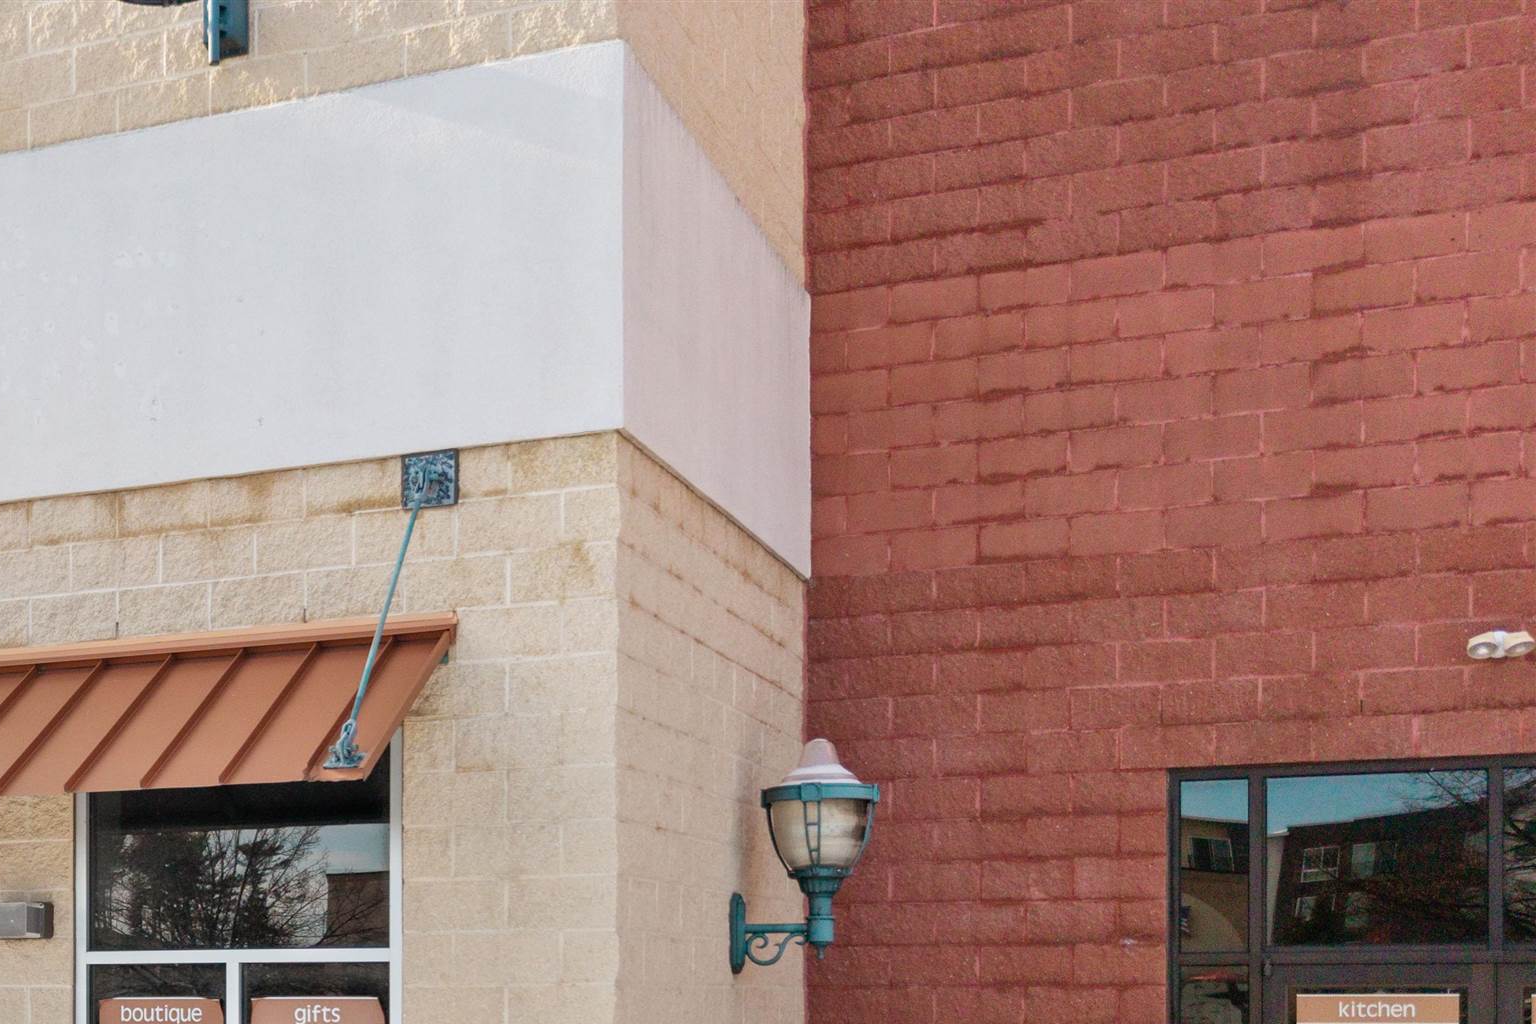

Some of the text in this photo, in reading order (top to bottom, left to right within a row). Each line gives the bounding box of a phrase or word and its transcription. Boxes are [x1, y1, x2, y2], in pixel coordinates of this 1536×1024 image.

[120, 1005, 202, 1024] boutique
[294, 1004, 341, 1024] gifts
[1338, 1001, 1415, 1018] kitchen
